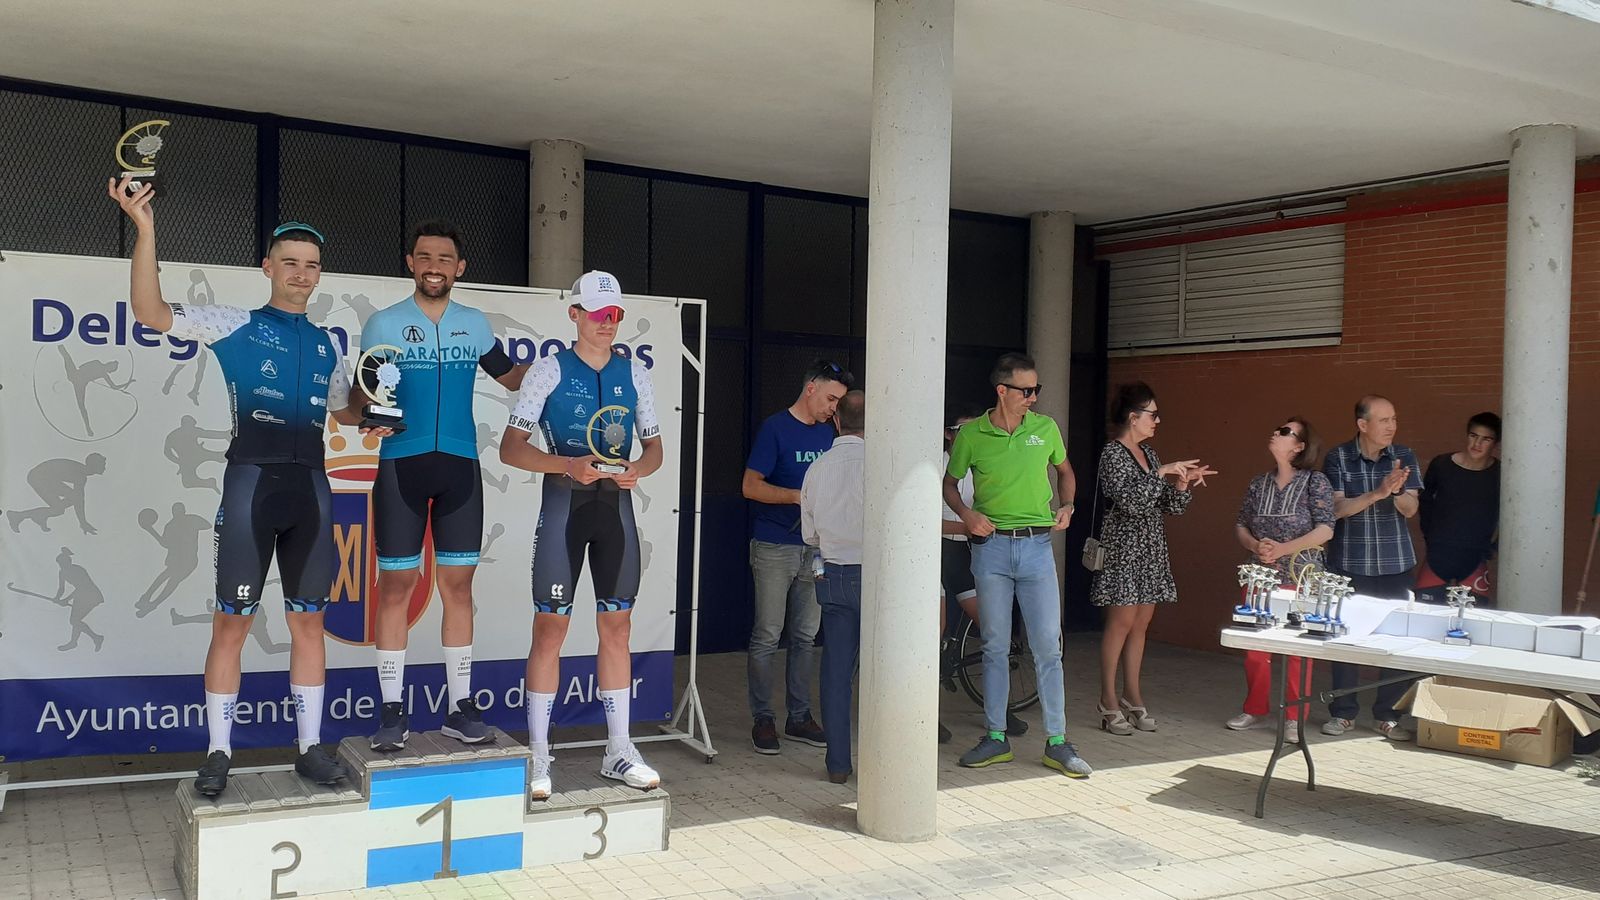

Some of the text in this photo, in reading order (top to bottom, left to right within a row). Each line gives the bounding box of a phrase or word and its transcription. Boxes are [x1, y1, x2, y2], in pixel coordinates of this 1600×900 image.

[36, 696, 297, 740] Ayuntament
[329, 687, 375, 720] de
[423, 683, 496, 715] Vo
[1463, 731, 1495, 740] CONTIENE
[1466, 738, 1493, 746] CRISTAL
[416, 795, 458, 879] 1
[583, 806, 608, 860] 3
[270, 841, 302, 899] 2
